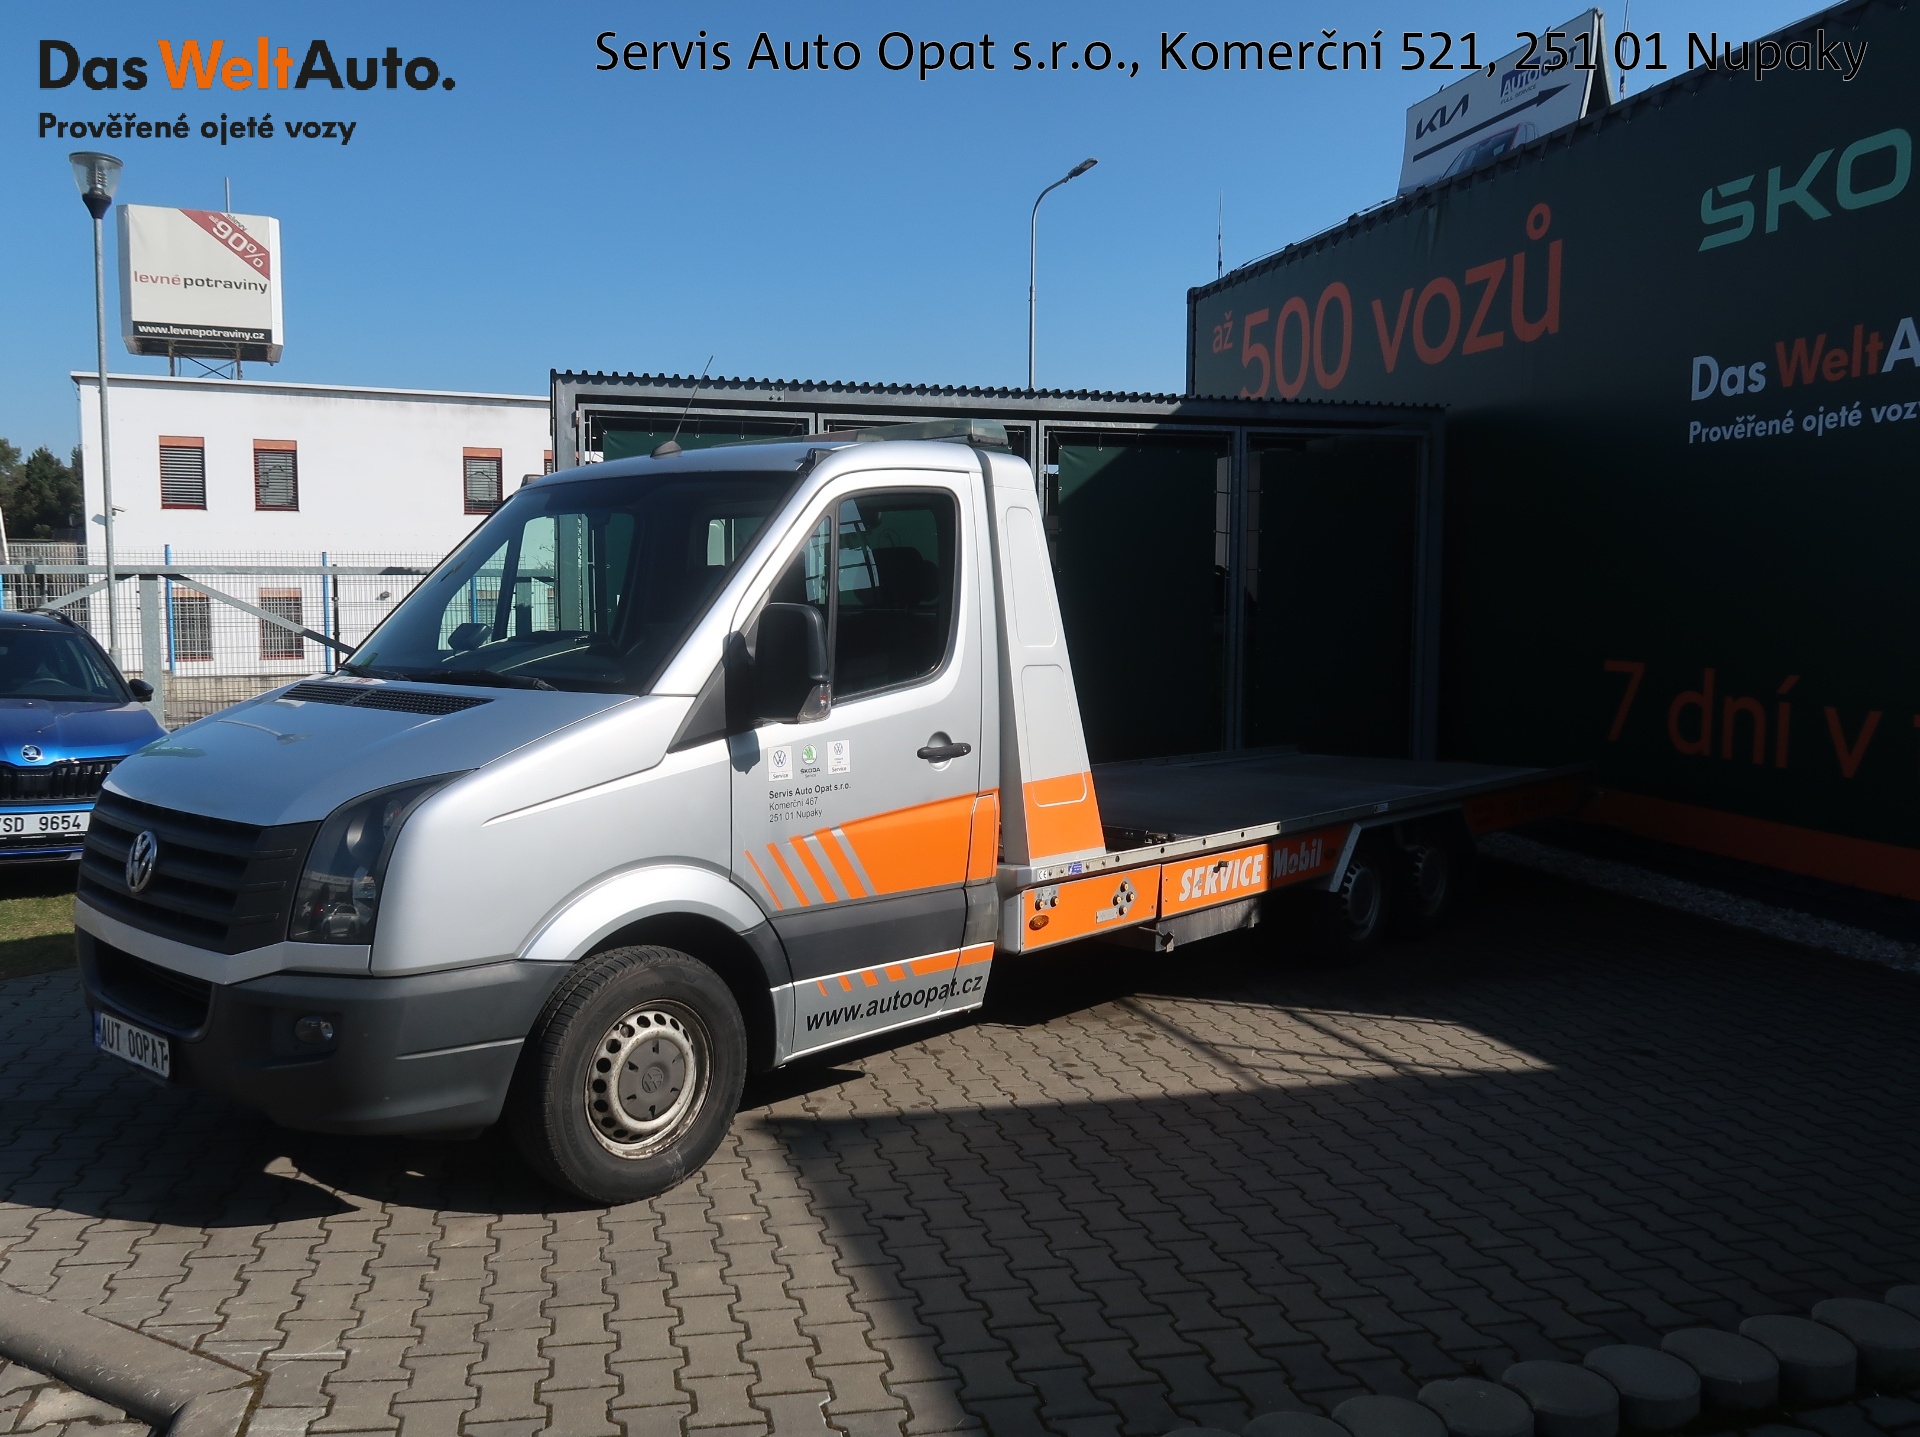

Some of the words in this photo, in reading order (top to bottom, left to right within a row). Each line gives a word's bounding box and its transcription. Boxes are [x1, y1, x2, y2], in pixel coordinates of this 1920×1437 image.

[1415, 93, 1470, 140] KIA
[212, 221, 266, 268] 90%
[1212, 310, 1233, 354] až
[1241, 281, 1353, 399] 500
[1371, 202, 1563, 374] vozů
[138, 325, 265, 341] www.levnepotraviny.cz
[1691, 355, 1767, 401] Das
[1688, 409, 1795, 445] Prověřené
[1802, 400, 1861, 437] ojeté
[1604, 659, 1646, 742] 7
[1667, 667, 1800, 769] dní
[1823, 706, 1884, 779] v
[769, 788, 793, 799] Servis
[795, 786, 813, 796] Auto
[814, 784, 833, 795] Opat
[833, 782, 851, 791] s.r.o.
[769, 799, 804, 811] Komerční
[805, 796, 819, 806] 467
[38, 814, 82, 832] 9654
[769, 813, 783, 823] 251
[784, 812, 794, 820] 01
[796, 808, 823, 819] Nupaky
[1178, 853, 1264, 902] SERVICE
[1272, 838, 1323, 879] Mobil
[806, 975, 984, 1031] www.autoopat.cz
[102, 1017, 121, 1052] AUT
